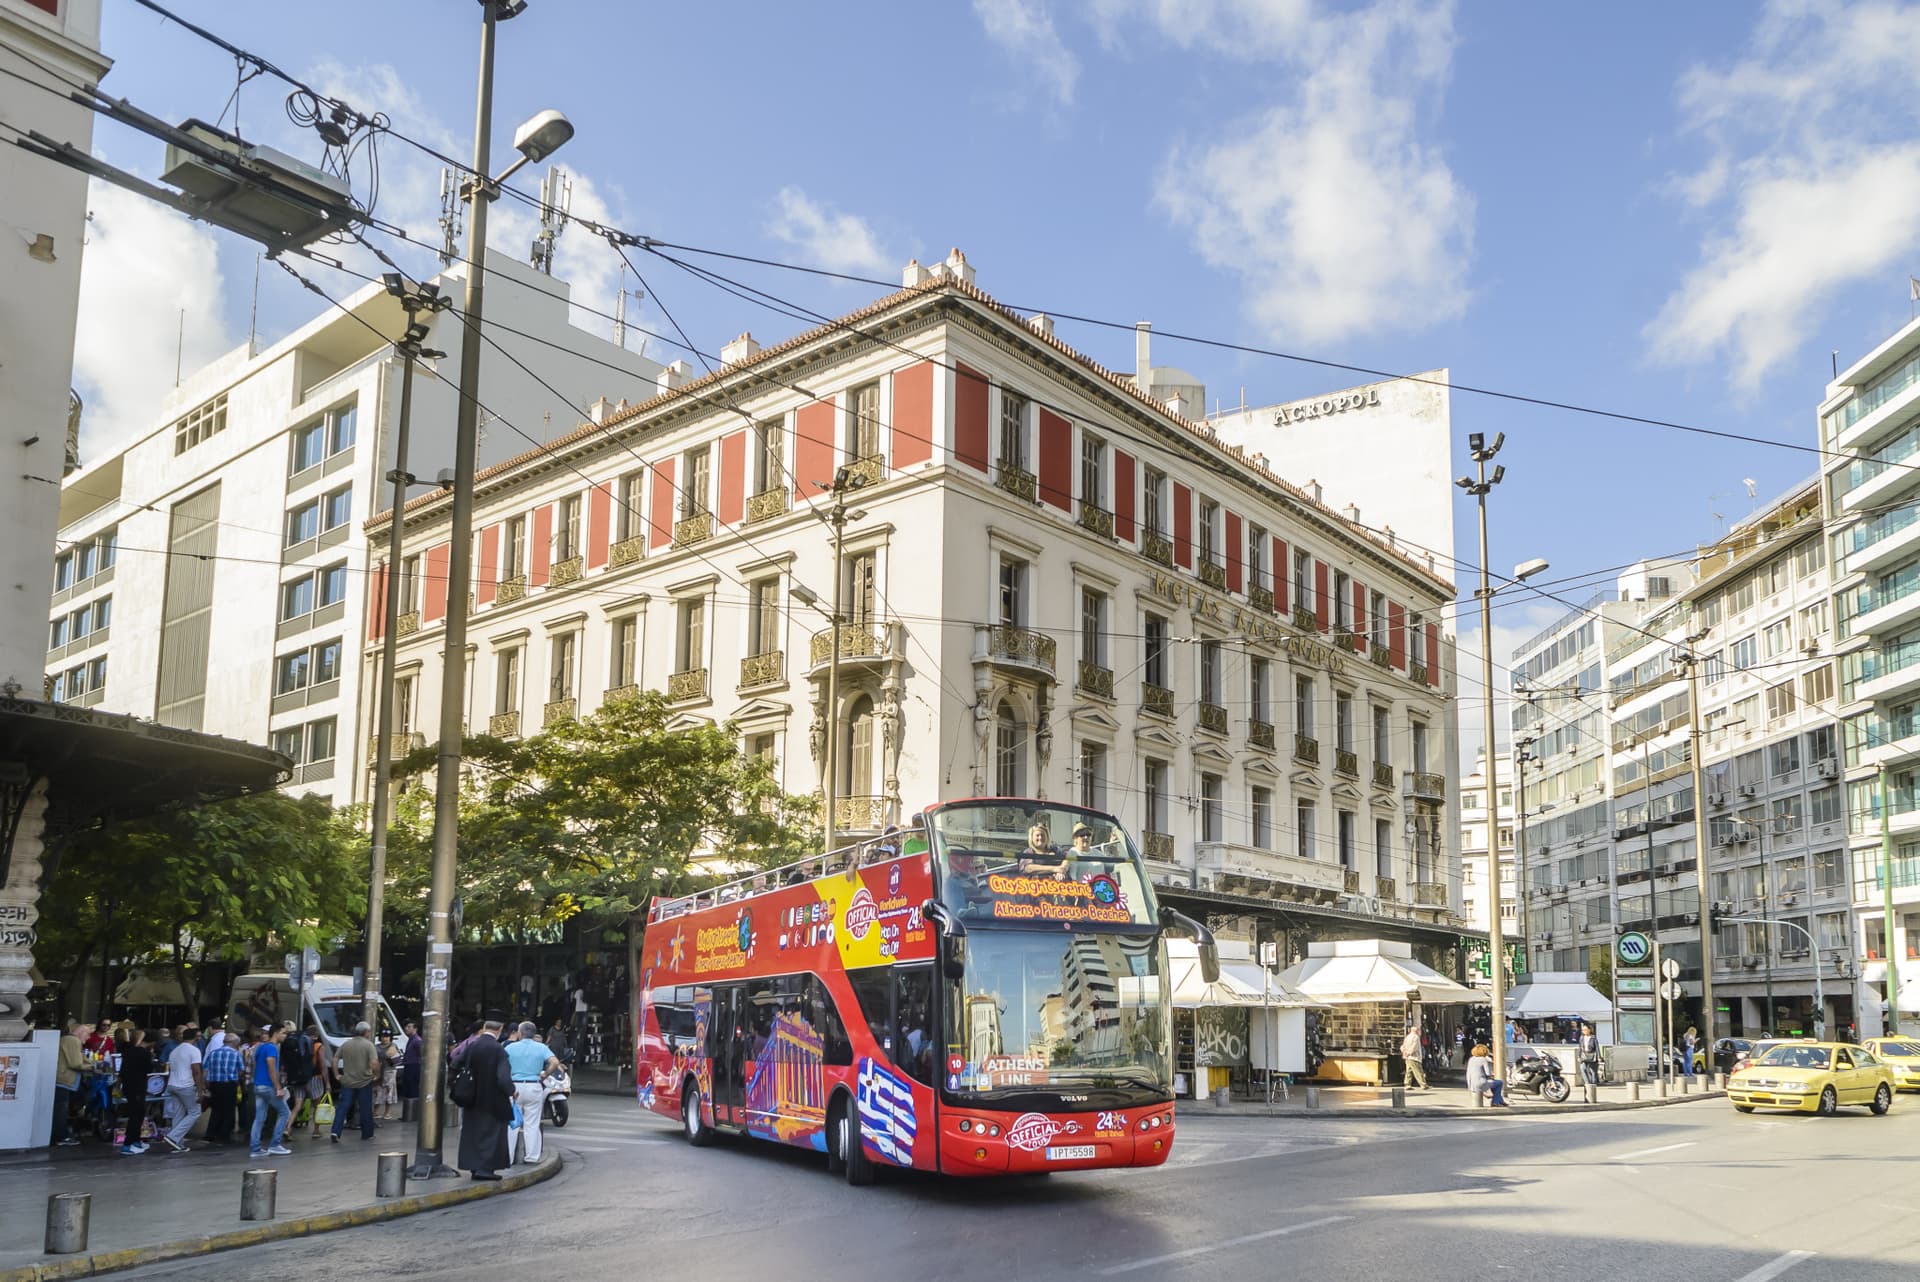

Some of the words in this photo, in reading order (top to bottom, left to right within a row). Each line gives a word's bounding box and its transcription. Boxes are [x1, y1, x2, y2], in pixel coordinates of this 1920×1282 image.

[1273, 389, 1381, 427] ACROPOL
[1155, 572, 1223, 624] ΜΕΓΑΣ
[989, 875, 1096, 899] CitySightseeing
[847, 906, 877, 926] OFFICIAL
[994, 901, 1034, 917] Athens
[1040, 901, 1081, 918] Piraeus
[1088, 904, 1130, 922] Beaches
[951, 1059, 962, 1069] 10
[986, 1058, 1045, 1071] ATHENS
[1000, 1073, 1032, 1085] LINE
[1096, 1112, 1112, 1130] 24
[1011, 1123, 1059, 1143] OFFICIAL
